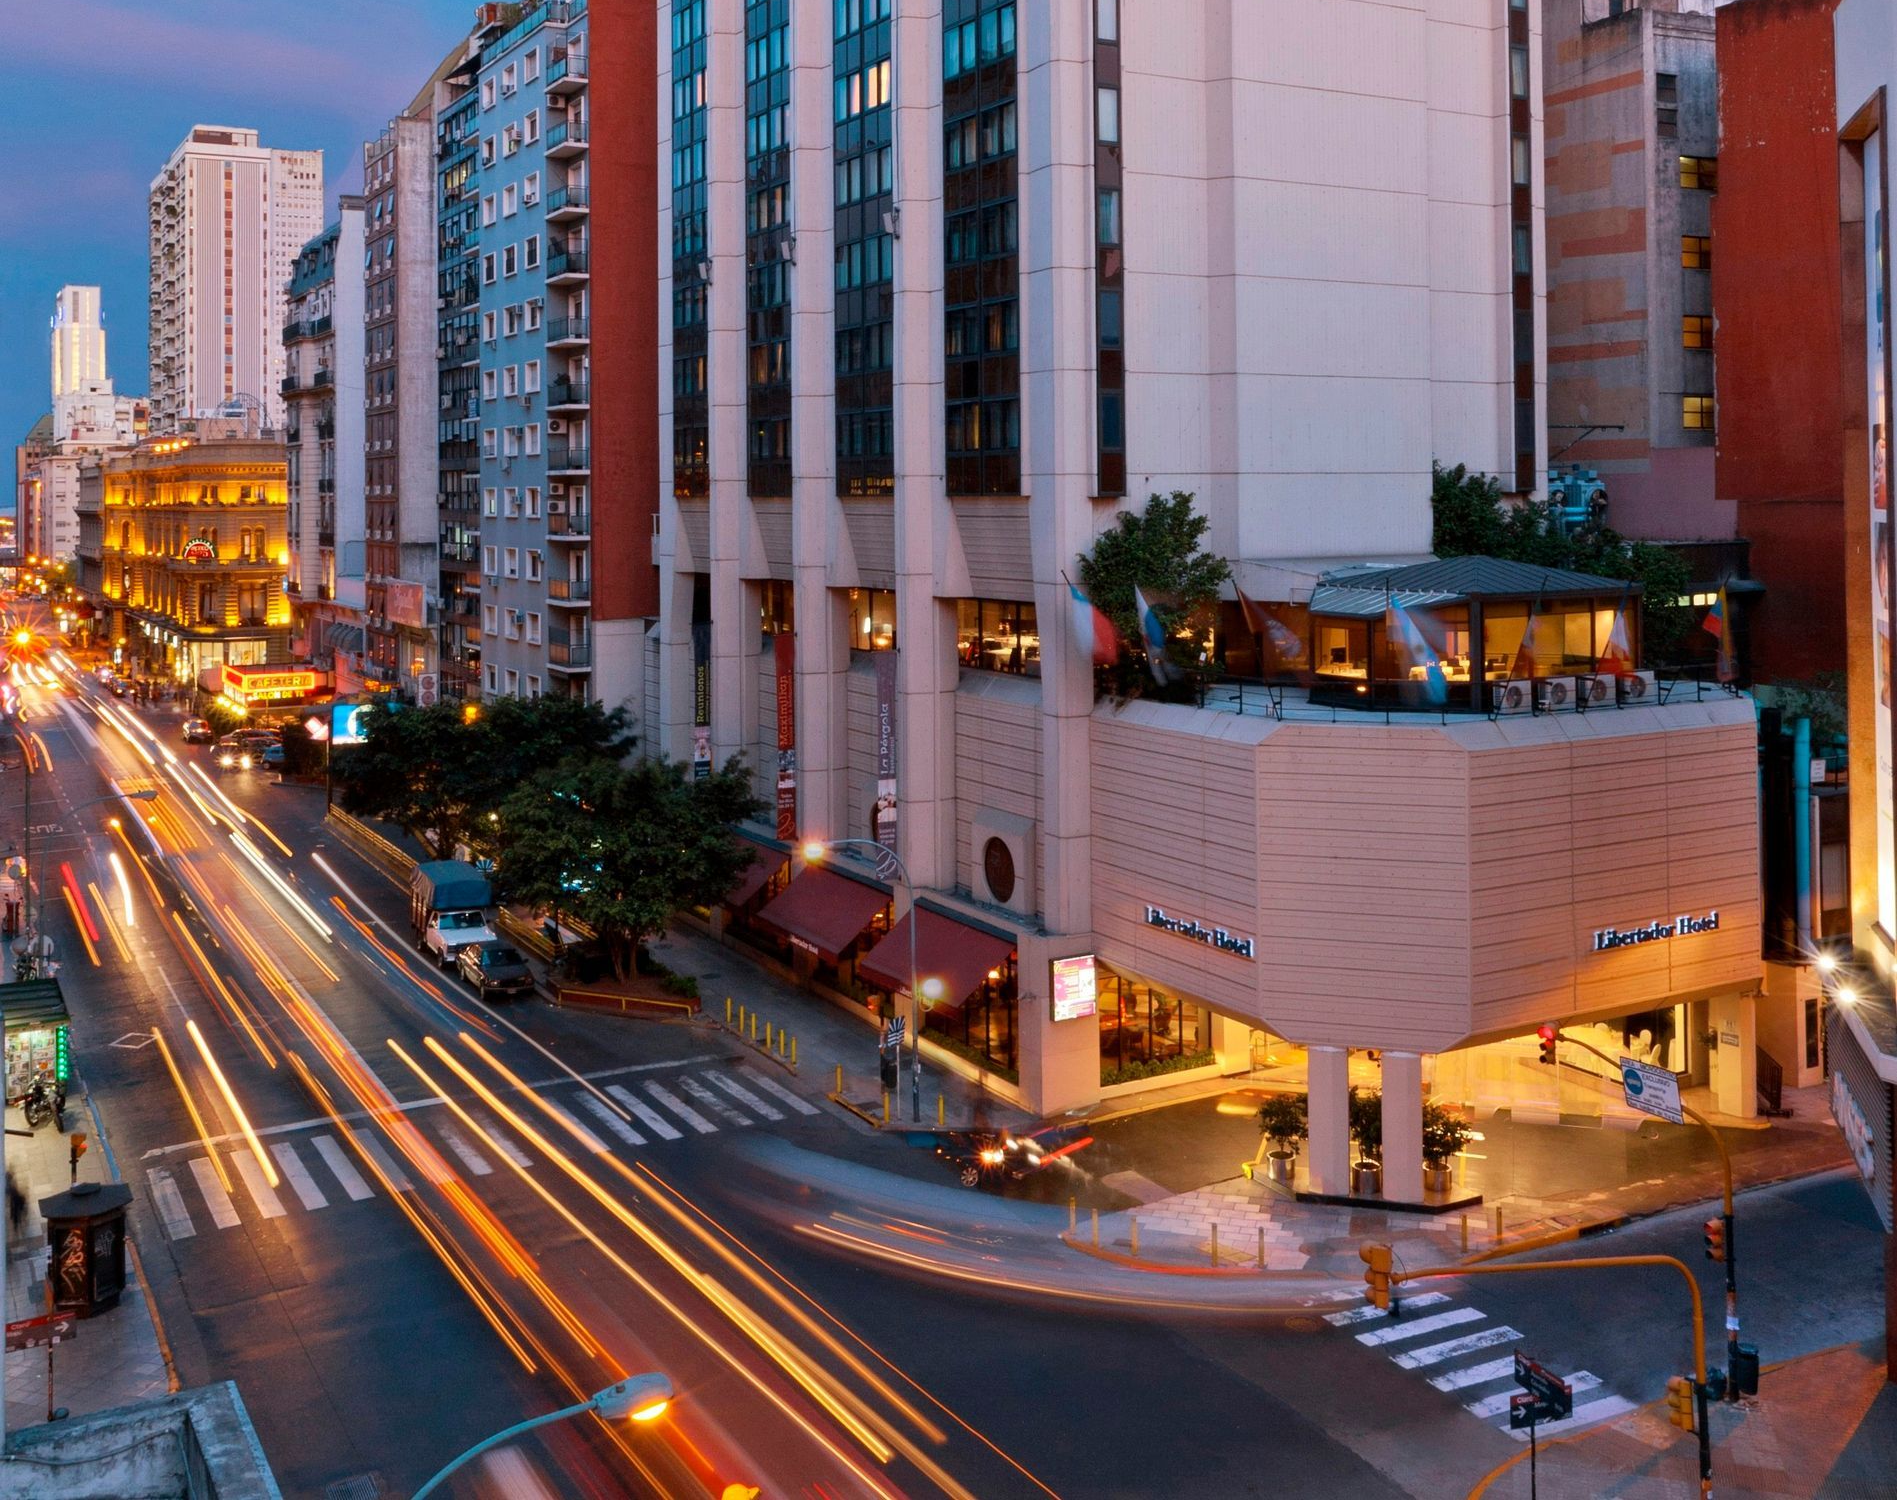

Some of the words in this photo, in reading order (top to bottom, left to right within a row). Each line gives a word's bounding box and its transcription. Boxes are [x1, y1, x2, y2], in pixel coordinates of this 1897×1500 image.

[1145, 905, 1213, 943] Libertador
[1213, 927, 1254, 958] Hotel
[1594, 920, 1676, 950] Libertador
[1676, 910, 1719, 935] Hotel
